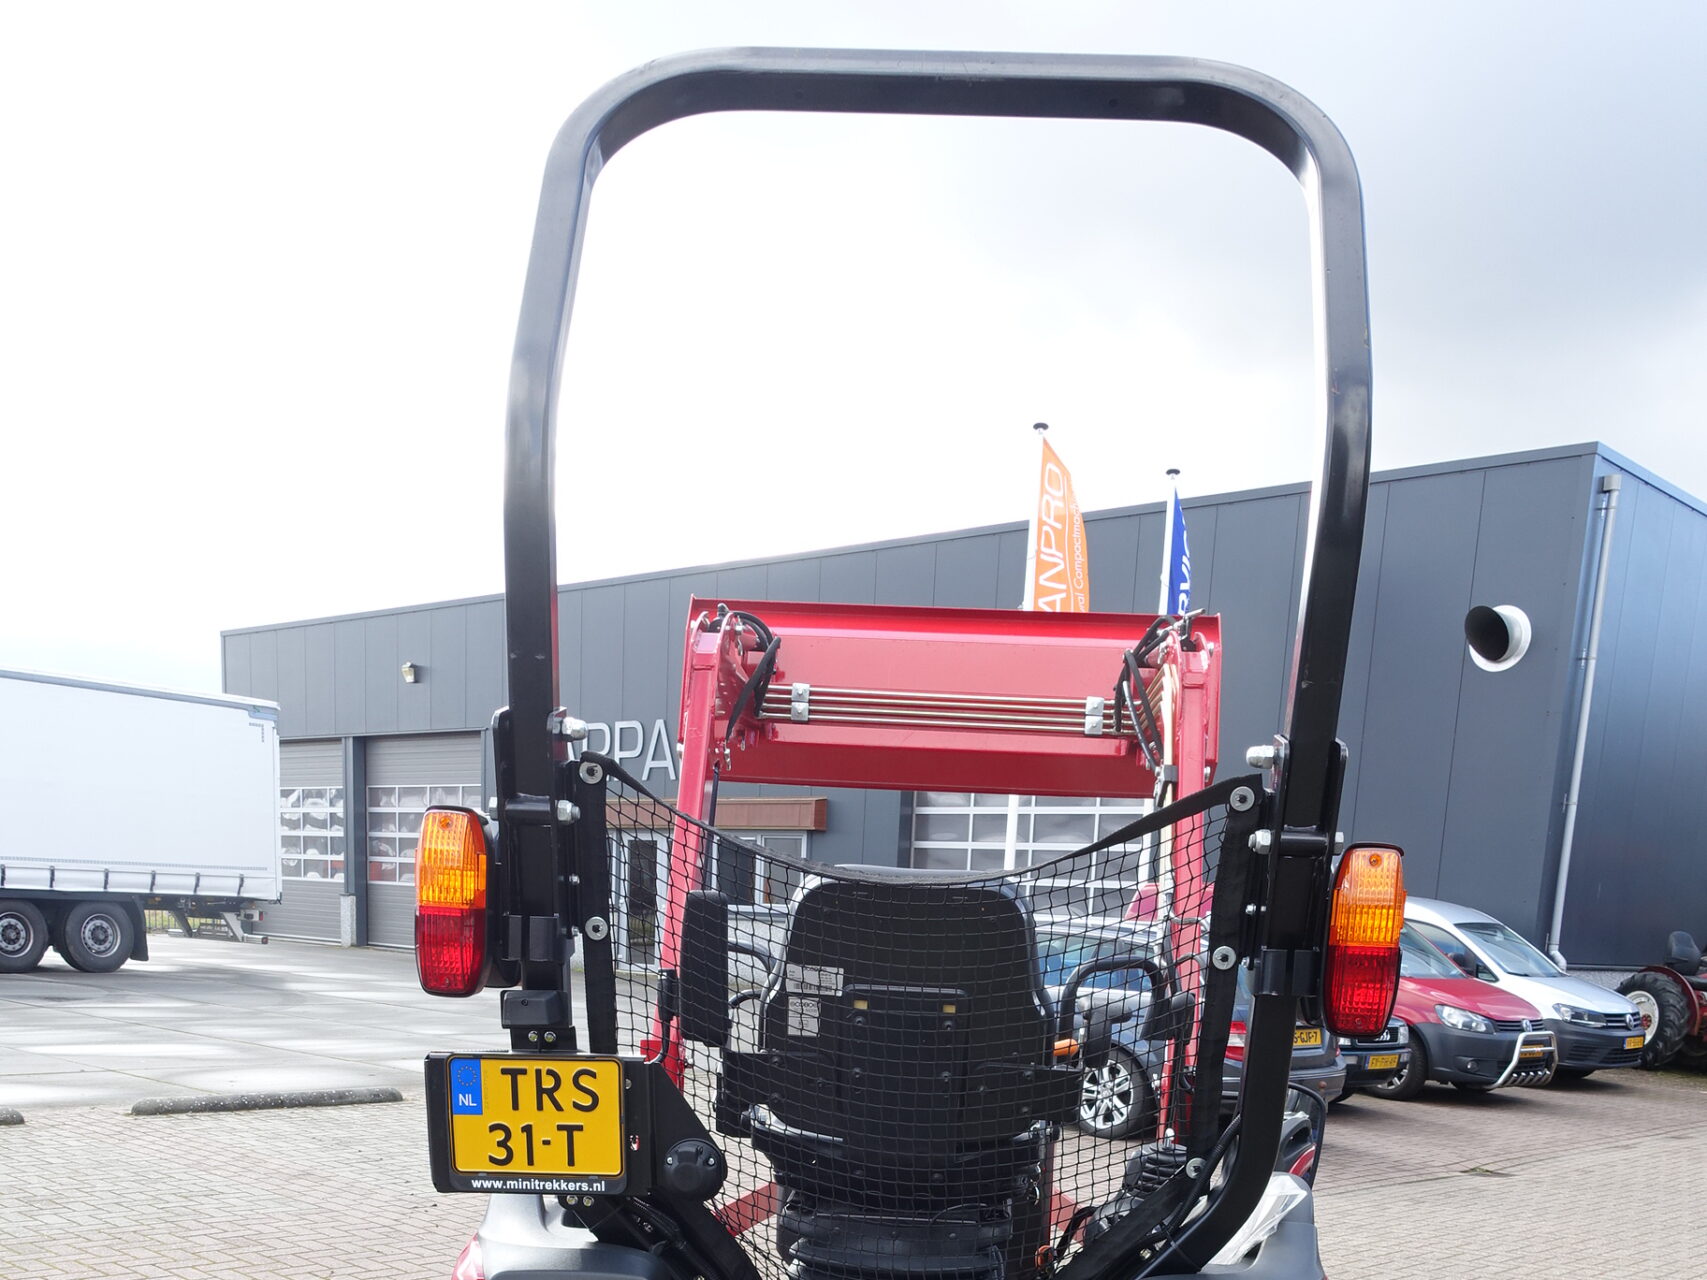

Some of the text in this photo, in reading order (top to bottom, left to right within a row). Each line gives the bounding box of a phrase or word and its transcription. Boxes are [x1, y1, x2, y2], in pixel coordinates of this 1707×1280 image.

[458, 1093, 477, 1107] NL
[500, 1067, 600, 1112] TRS
[487, 1122, 584, 1167] 31-T
[471, 1178, 606, 1192] www.minitrekkers.nl
